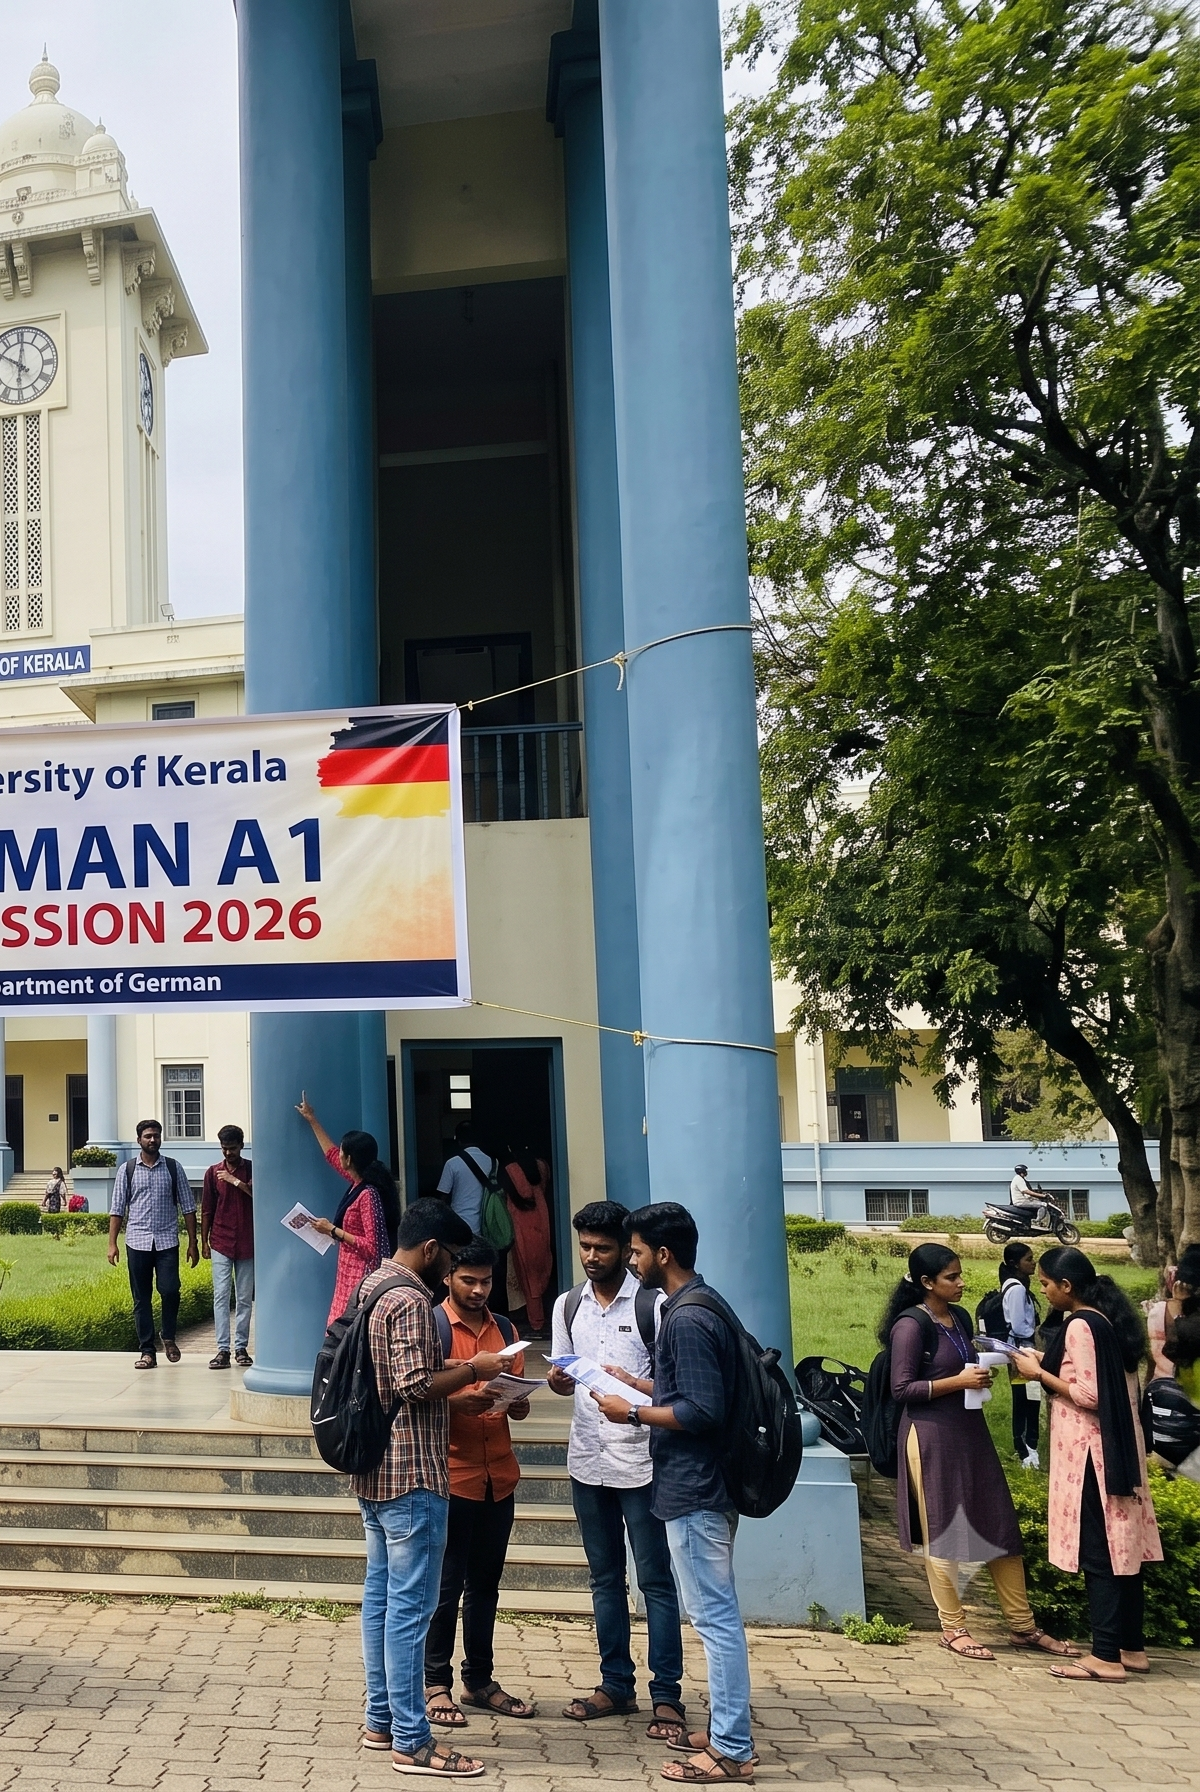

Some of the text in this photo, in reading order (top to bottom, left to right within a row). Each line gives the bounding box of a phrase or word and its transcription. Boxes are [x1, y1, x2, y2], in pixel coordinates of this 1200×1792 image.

[0, 656, 20, 676] OF
[23, 650, 86, 674] KERALA
[105, 754, 148, 790] of
[157, 749, 288, 787] Kerala
[216, 817, 323, 886] A1
[183, 896, 322, 943] 2026
[99, 972, 125, 994] of
[128, 971, 222, 993] German
